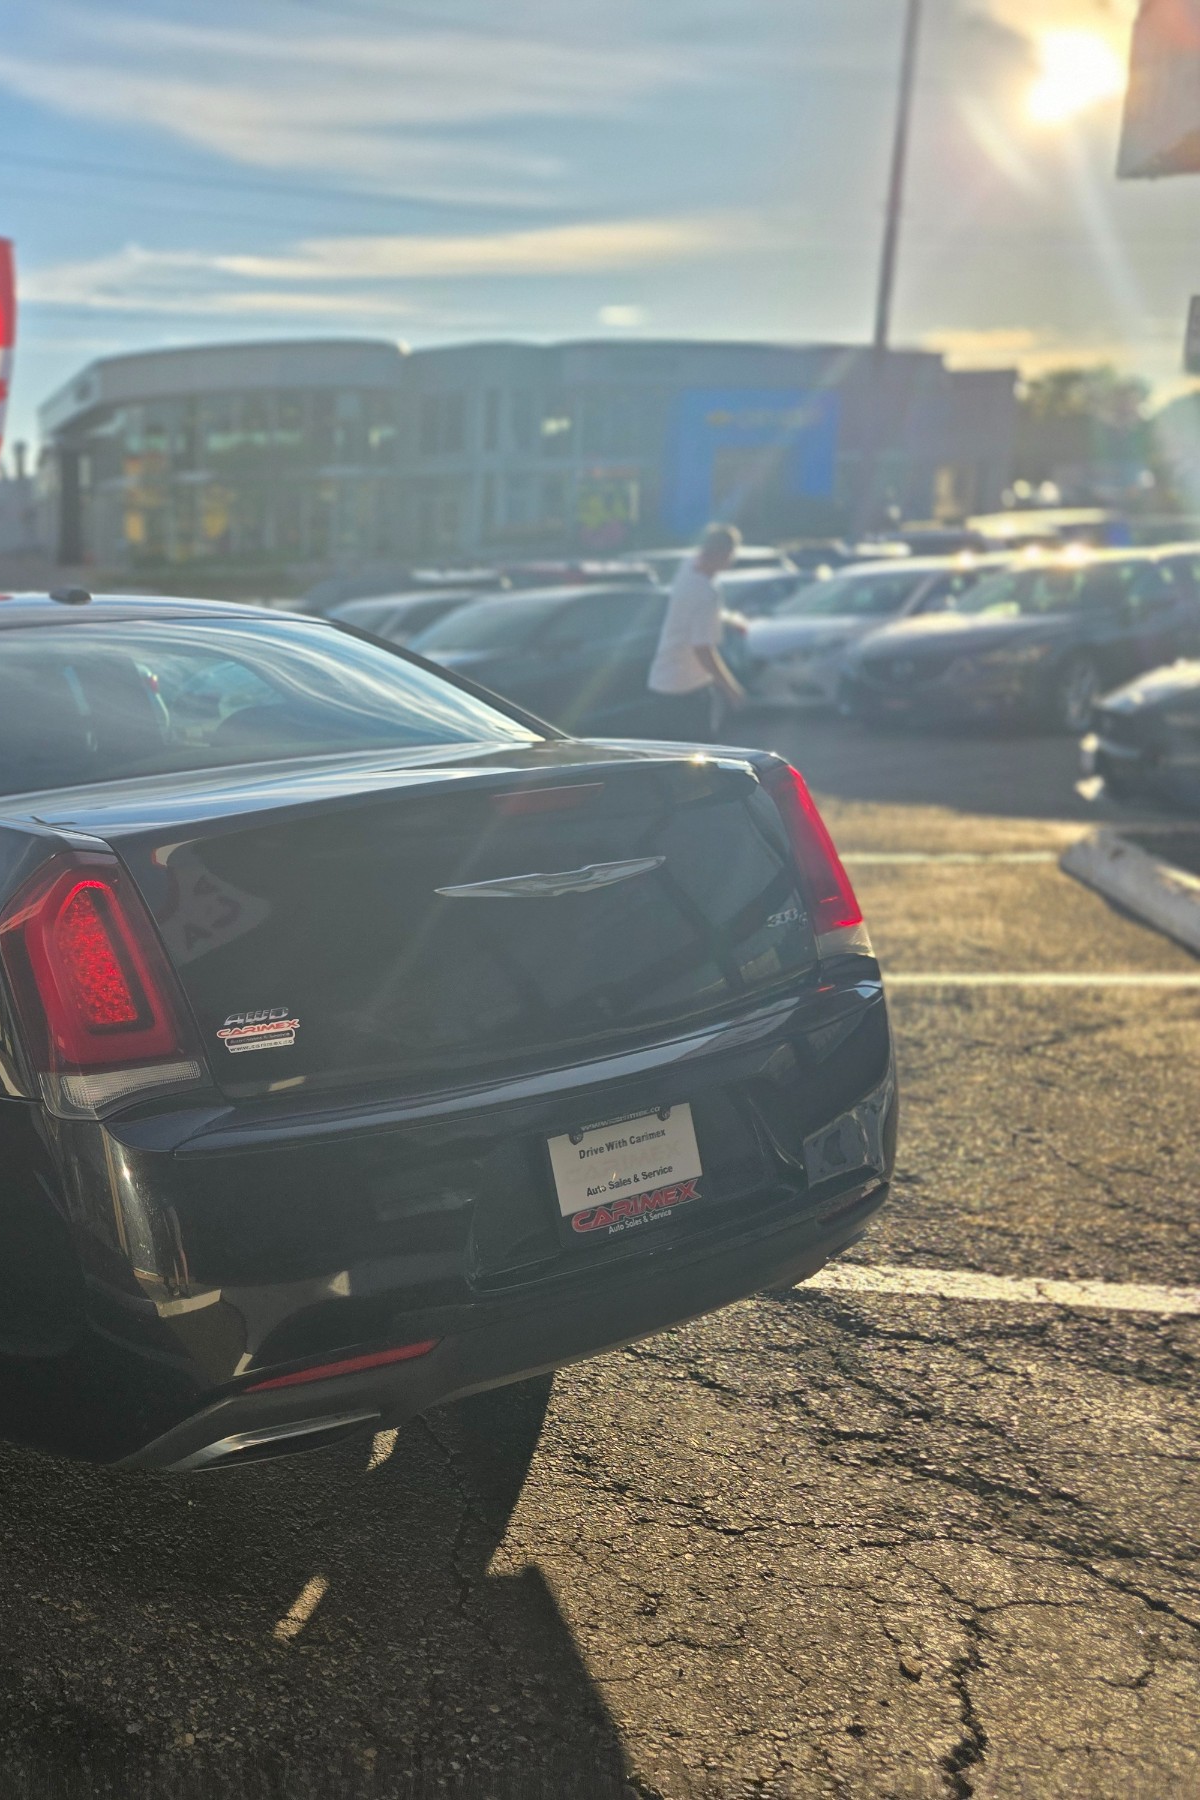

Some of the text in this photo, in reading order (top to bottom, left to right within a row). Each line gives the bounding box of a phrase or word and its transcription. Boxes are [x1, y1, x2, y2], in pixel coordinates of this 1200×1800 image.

[217, 1019, 300, 1038] CARIMEX
[223, 1006, 289, 1026] AWD
[579, 1128, 666, 1160] Drive With Carimex
[586, 1164, 674, 1197] Auto Sales & Service
[571, 1178, 702, 1233] CARIMEX
[608, 1209, 672, 1235] Auto Sales & Service
